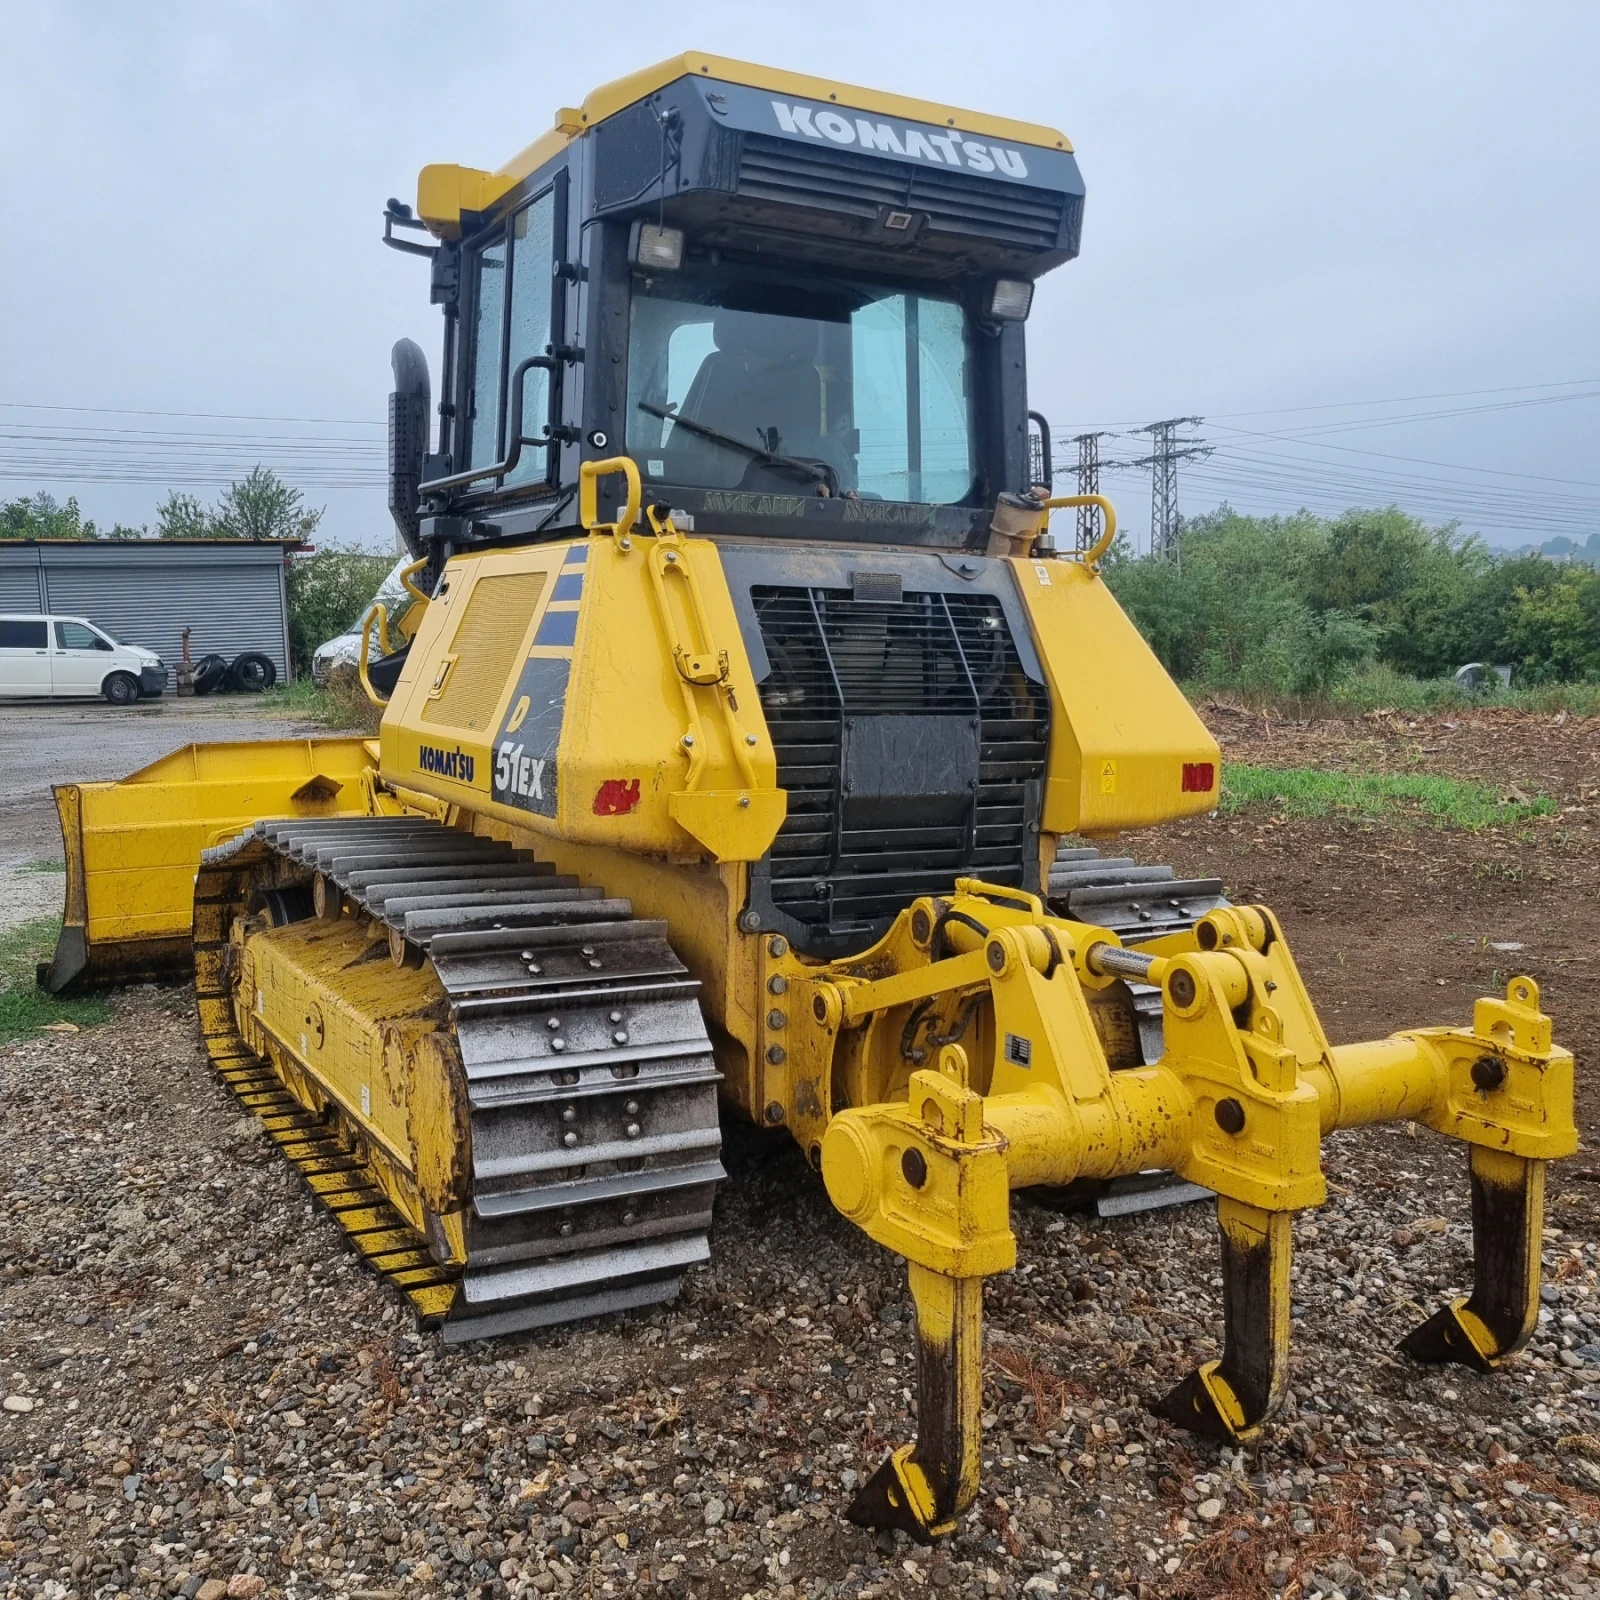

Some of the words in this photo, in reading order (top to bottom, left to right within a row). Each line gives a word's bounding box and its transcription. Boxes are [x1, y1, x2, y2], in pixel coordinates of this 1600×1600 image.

[771, 101, 1028, 178] KOMATSU
[505, 695, 530, 732] D
[420, 745, 474, 782] KOMATSU
[495, 741, 546, 799] 51EX
